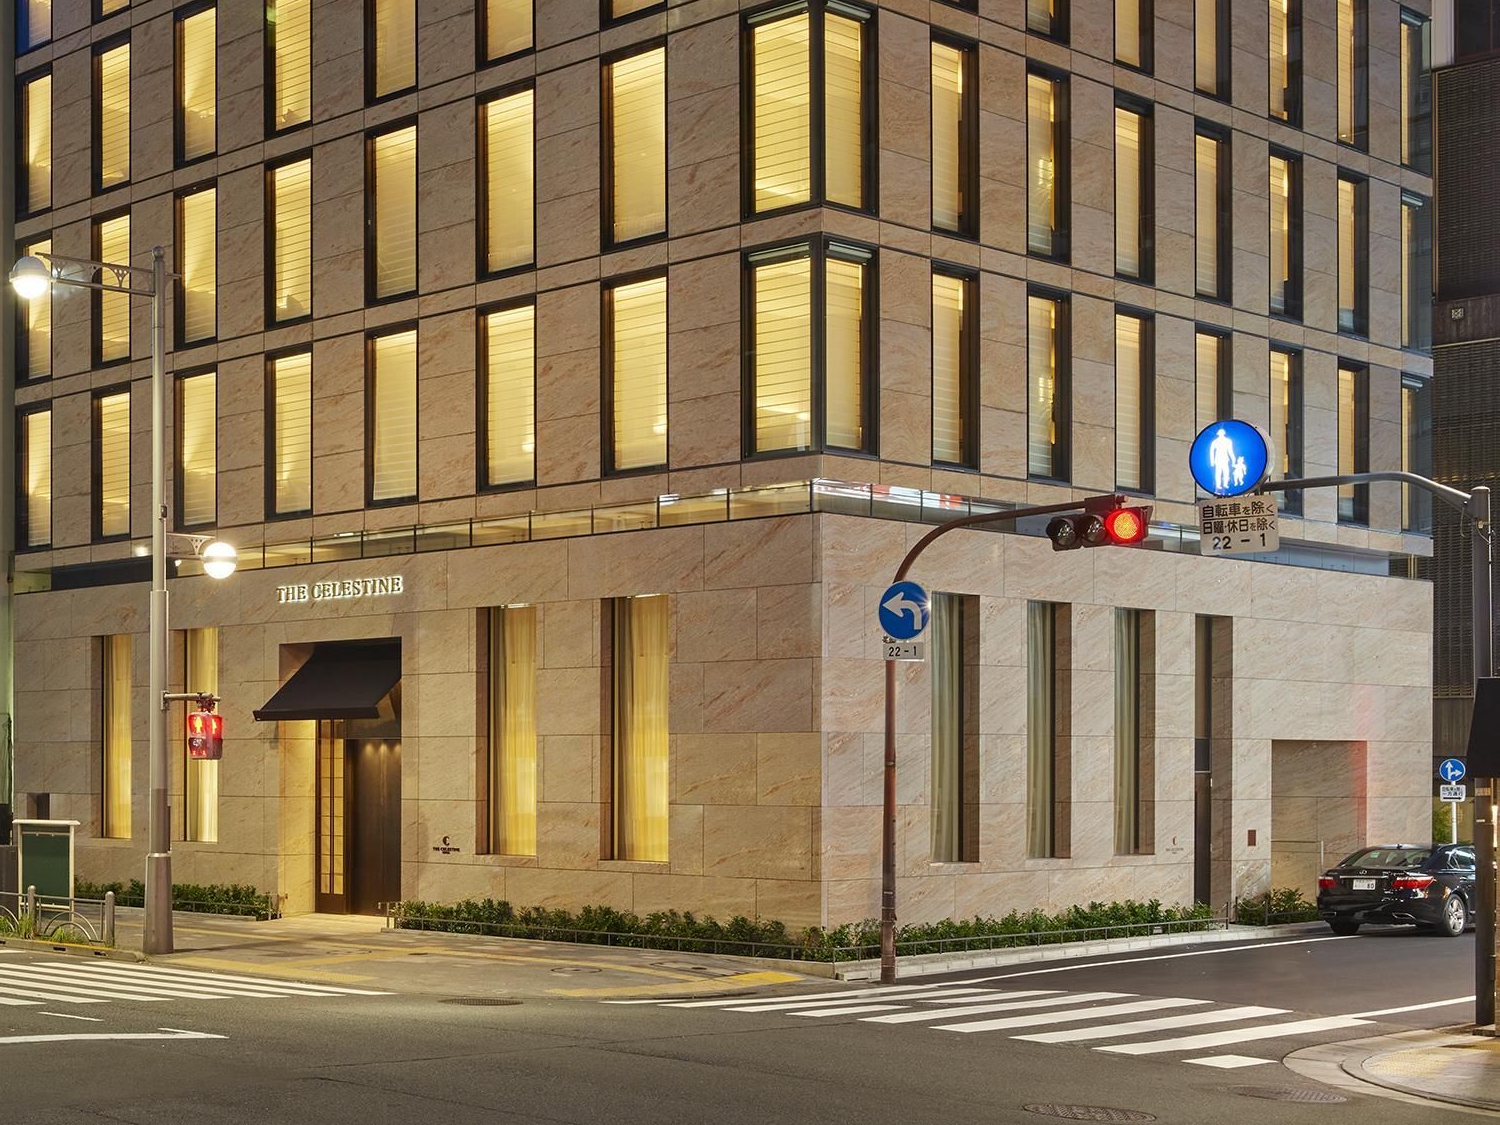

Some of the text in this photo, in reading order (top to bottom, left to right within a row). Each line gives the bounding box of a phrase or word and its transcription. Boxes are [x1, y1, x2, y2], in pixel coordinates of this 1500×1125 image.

[1202, 501, 1275, 518] 自転車を除く
[1203, 517, 1276, 534] 日曜・休日を除く
[276, 577, 402, 602] THE CELESTINE
